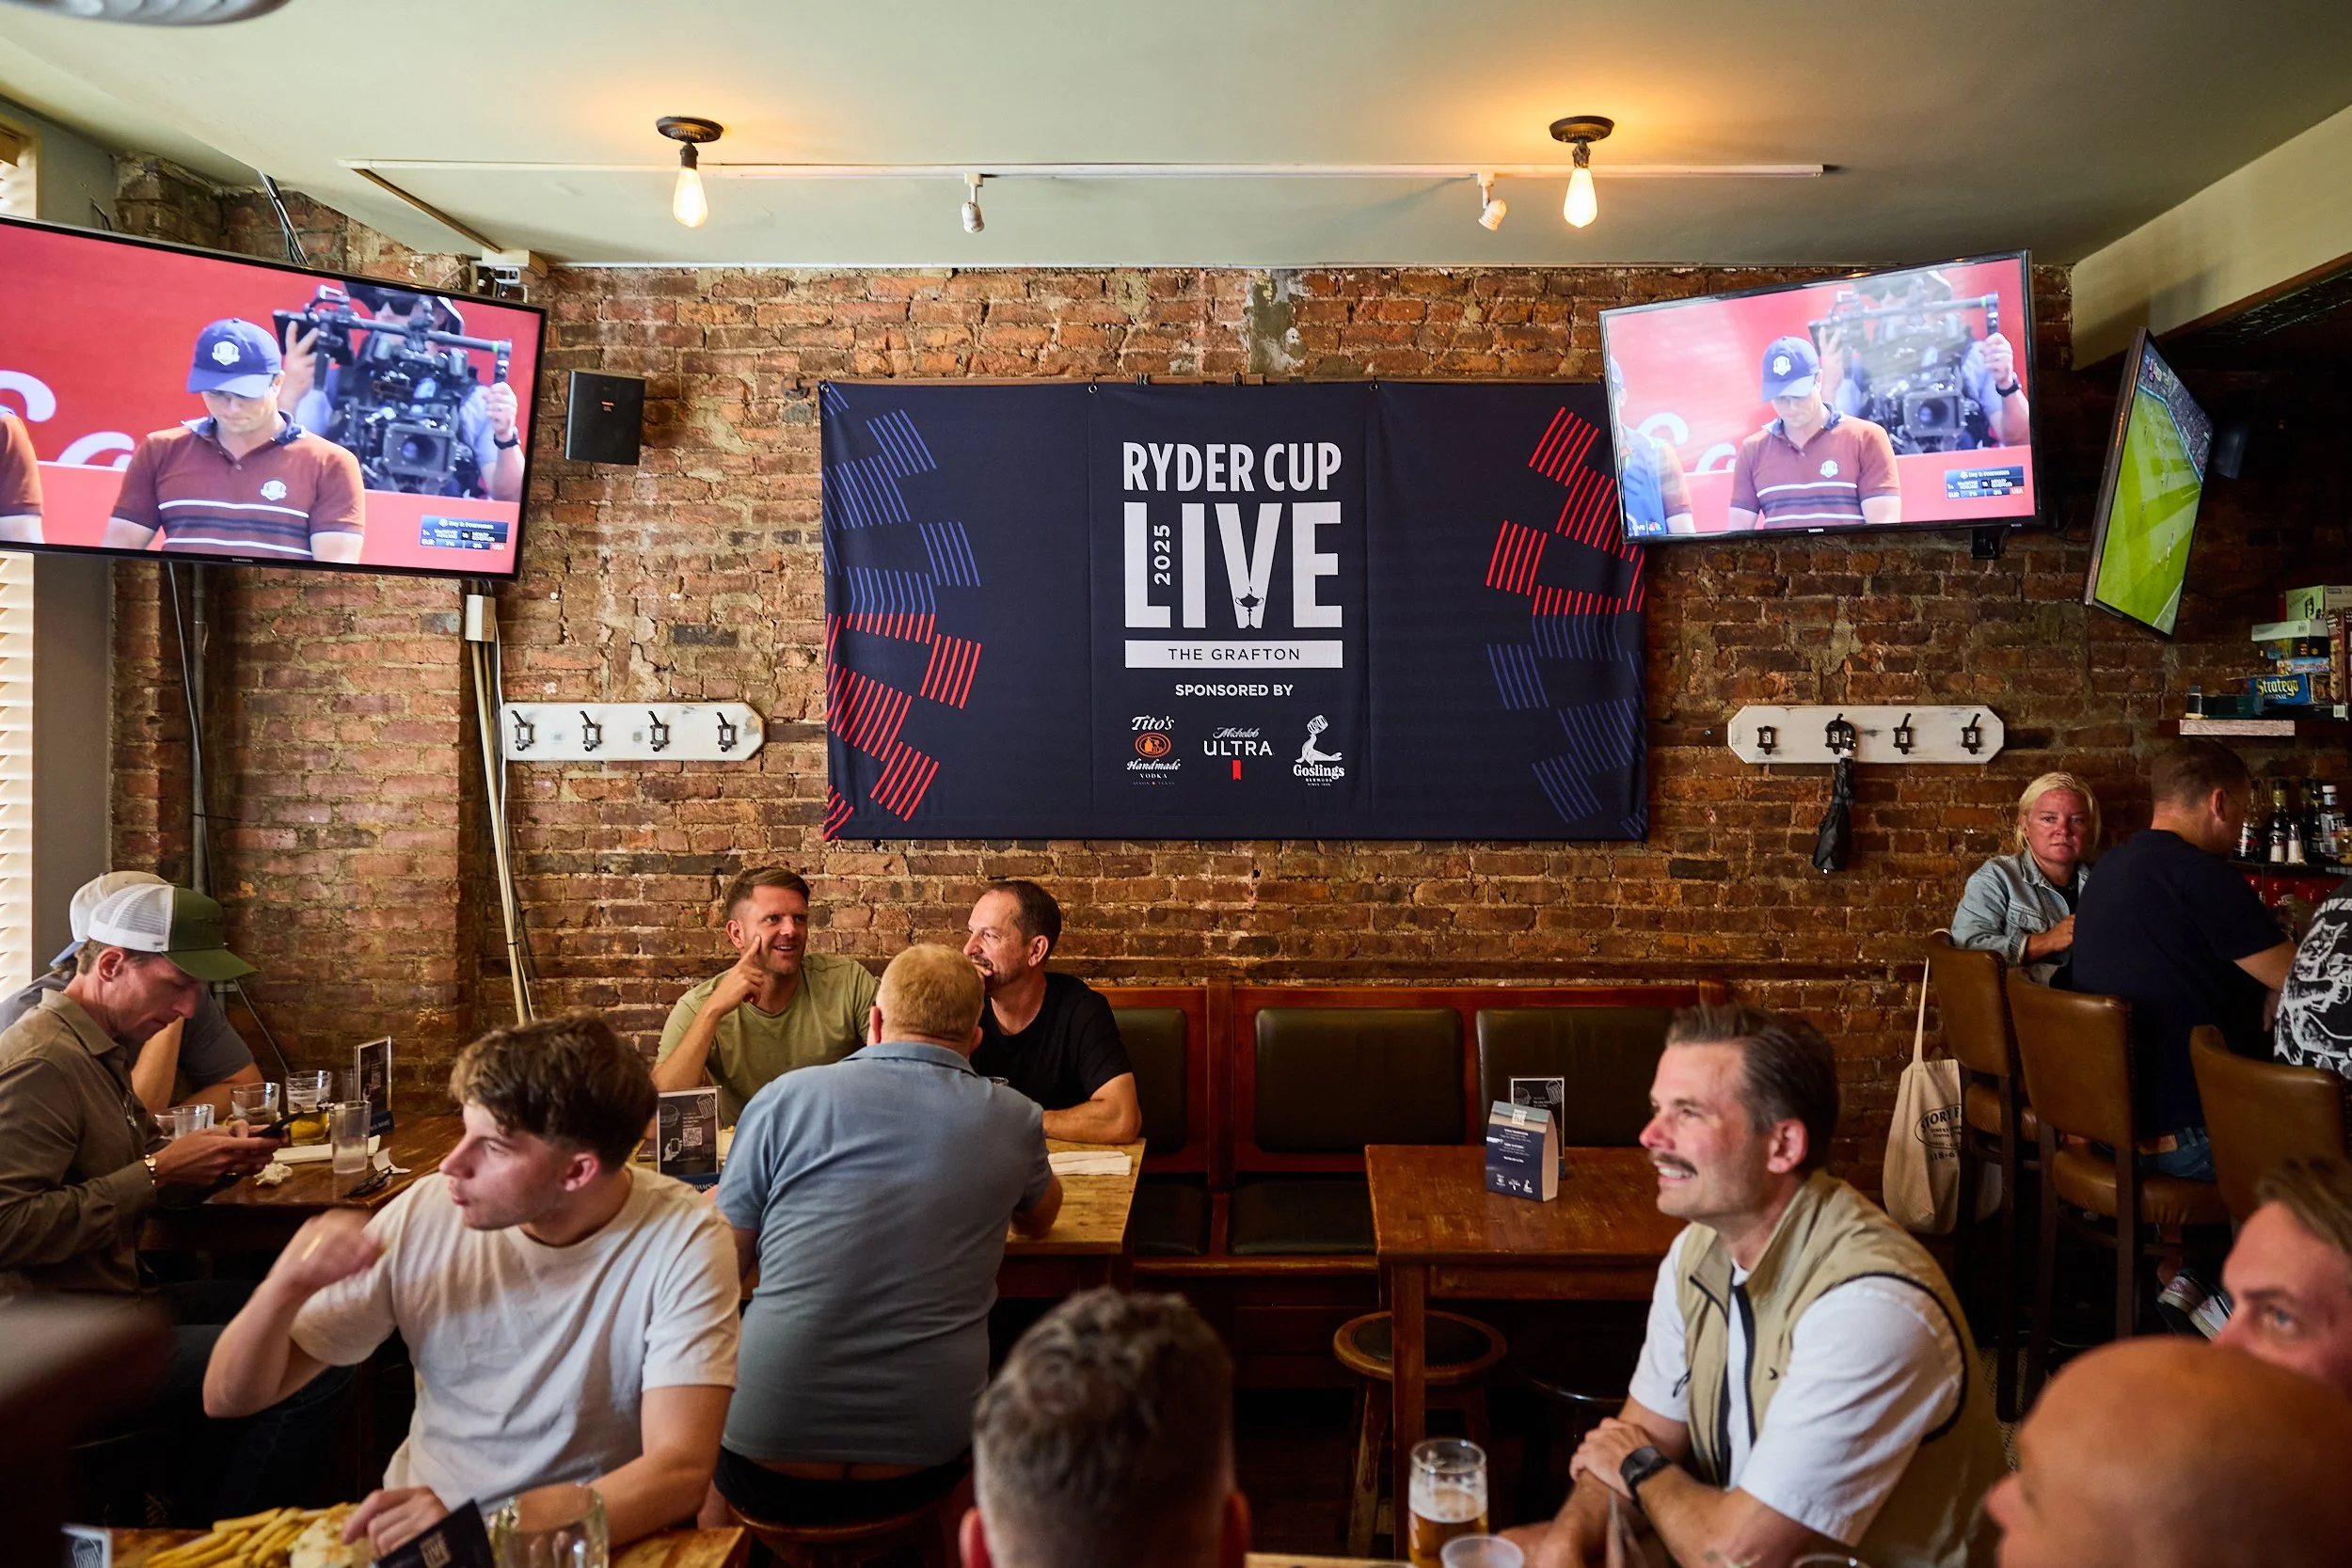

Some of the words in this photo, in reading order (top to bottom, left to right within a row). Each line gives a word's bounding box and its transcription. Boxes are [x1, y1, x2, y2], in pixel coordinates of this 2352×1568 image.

[1123, 442, 1254, 491] RYDER
[1263, 442, 1342, 491] CUP
[1153, 525, 1170, 585] 2025
[1123, 501, 1343, 628] LIVE
[1168, 648, 1202, 660] THE
[1211, 648, 1300, 660] GRAFTON
[1175, 684, 1269, 697] SPONSORED
[1273, 684, 1294, 697] BY
[2256, 677, 2299, 697] Stratego
[1131, 714, 1175, 731] Tito's
[1212, 727, 1260, 738] Michelob
[1203, 740, 1273, 756] ULTRA
[1126, 758, 1182, 770] Handmade
[1293, 764, 1345, 780] Goslings
[1920, 1109, 1951, 1133] STORY
